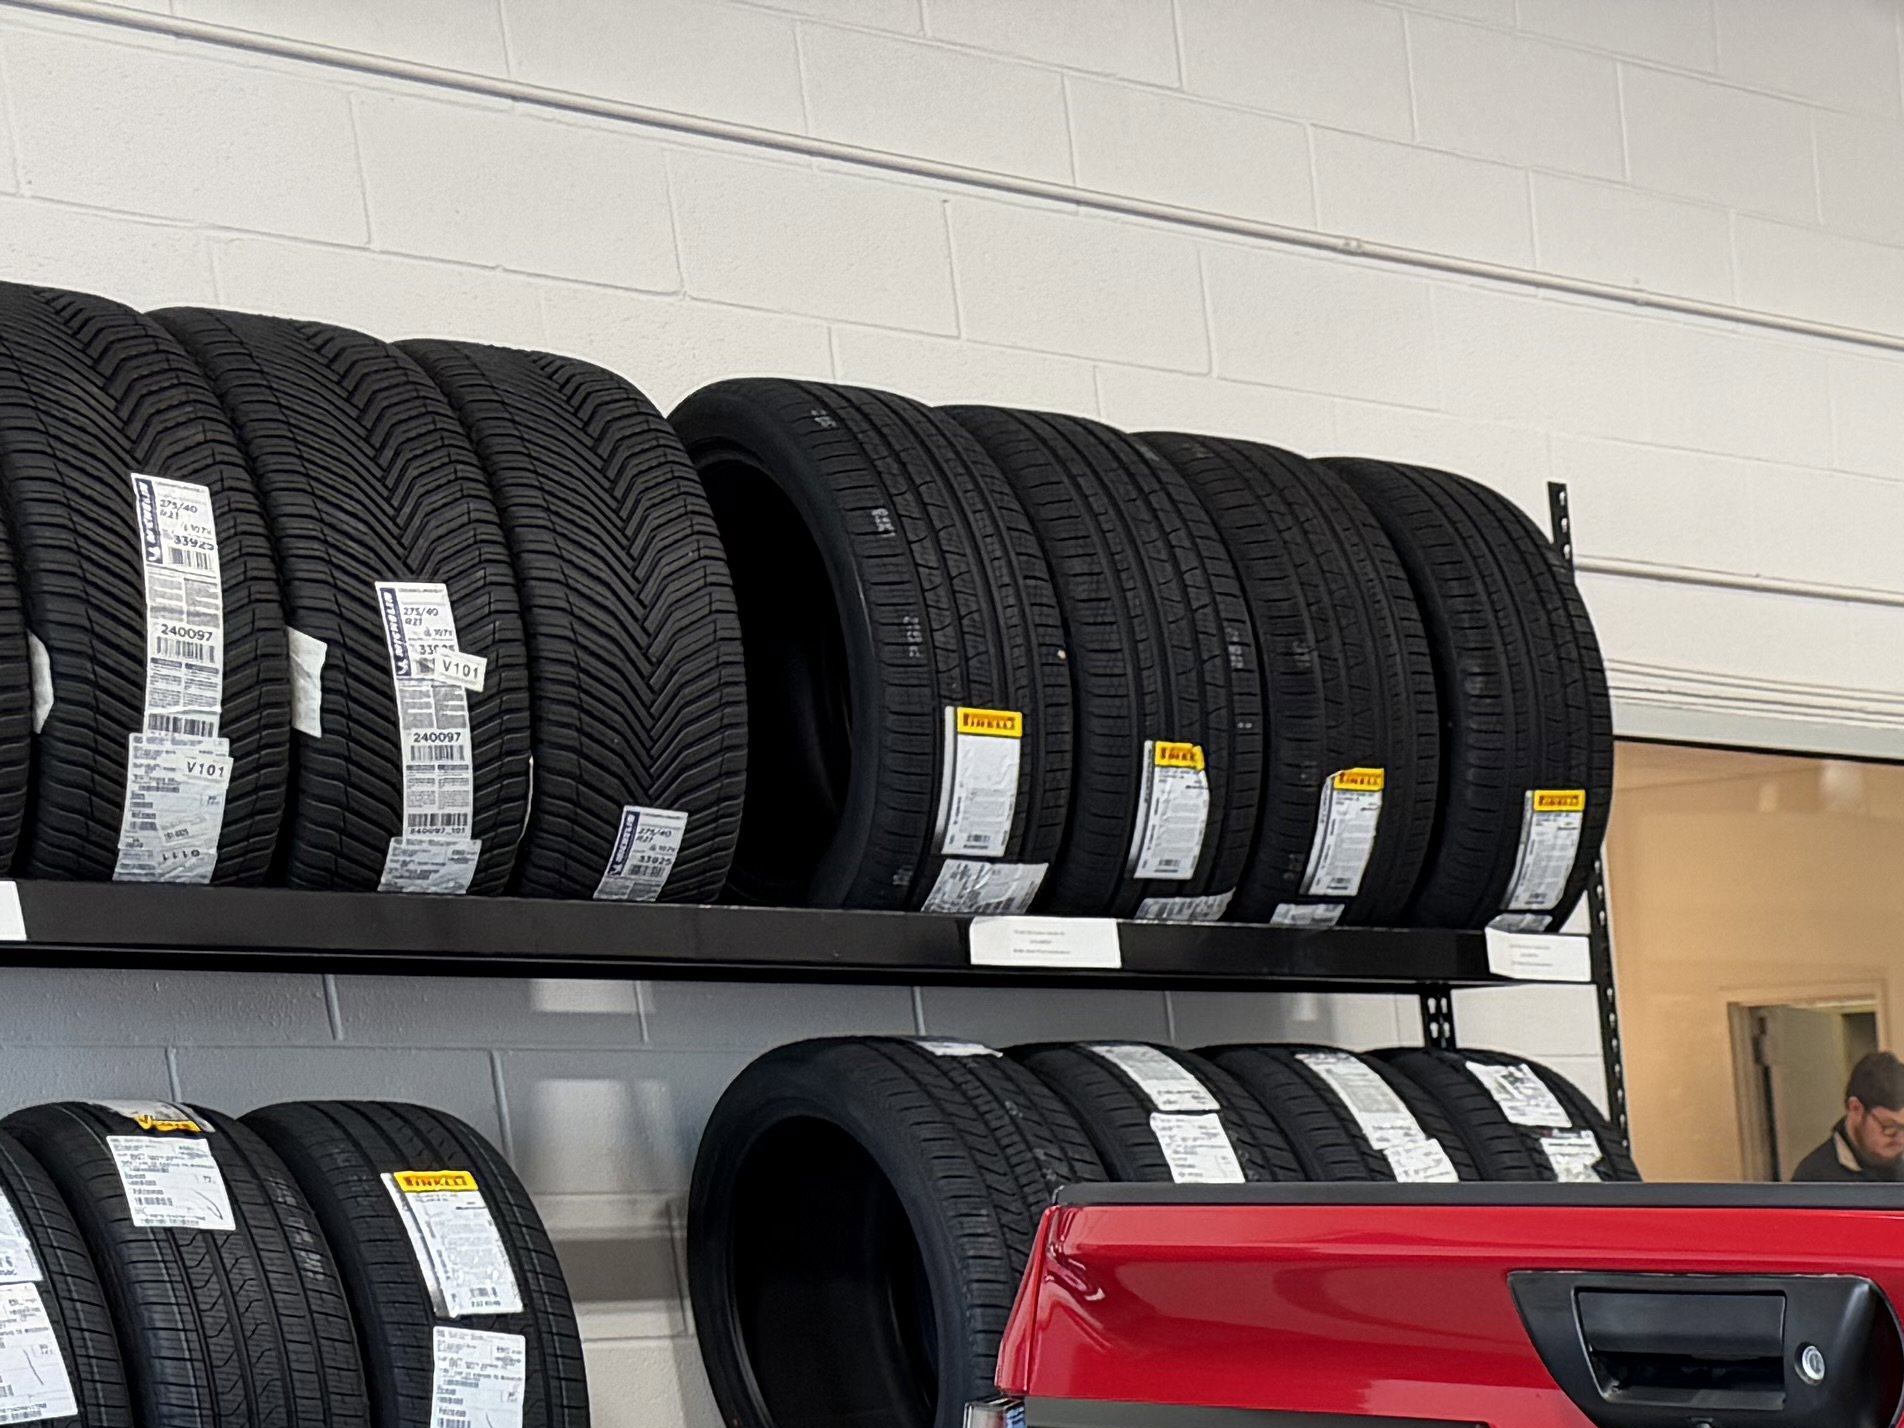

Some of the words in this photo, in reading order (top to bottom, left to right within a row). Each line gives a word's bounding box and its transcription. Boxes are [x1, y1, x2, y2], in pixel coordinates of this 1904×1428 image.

[160, 622, 213, 642] 240097
[442, 658, 480, 680] V101
[412, 731, 462, 744] 240097
[186, 760, 226, 779] V101
